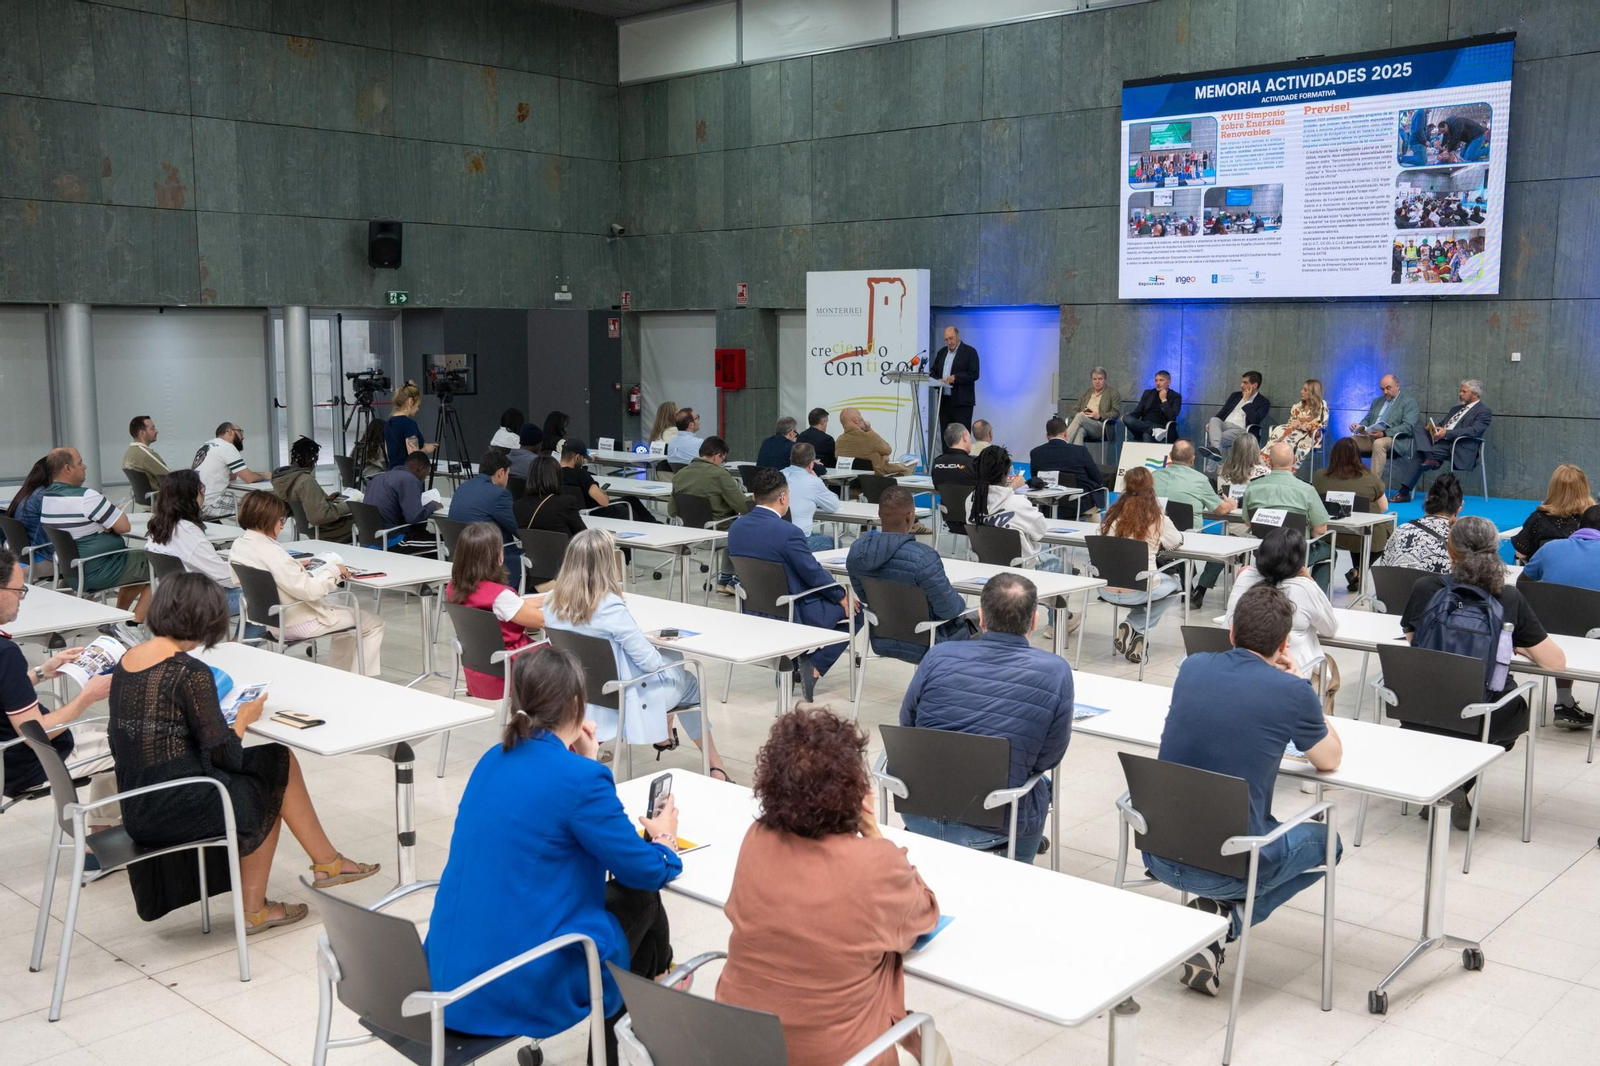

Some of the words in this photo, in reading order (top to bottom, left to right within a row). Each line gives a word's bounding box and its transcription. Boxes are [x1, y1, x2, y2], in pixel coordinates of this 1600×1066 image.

[1194, 79, 1262, 99] MEMORIA
[1265, 67, 1367, 93] ACTIVIDADES
[1371, 61, 1413, 81] 2025
[1261, 93, 1298, 104] ACTIVIDADE
[1299, 89, 1337, 99] FORMATIVA
[1303, 102, 1351, 115] Previsel
[1220, 112, 1244, 122] XVIII
[1245, 109, 1286, 121] Simposio
[1220, 121, 1244, 131] sobre
[1220, 127, 1272, 139] Renovables
[811, 338, 889, 358] creciendo
